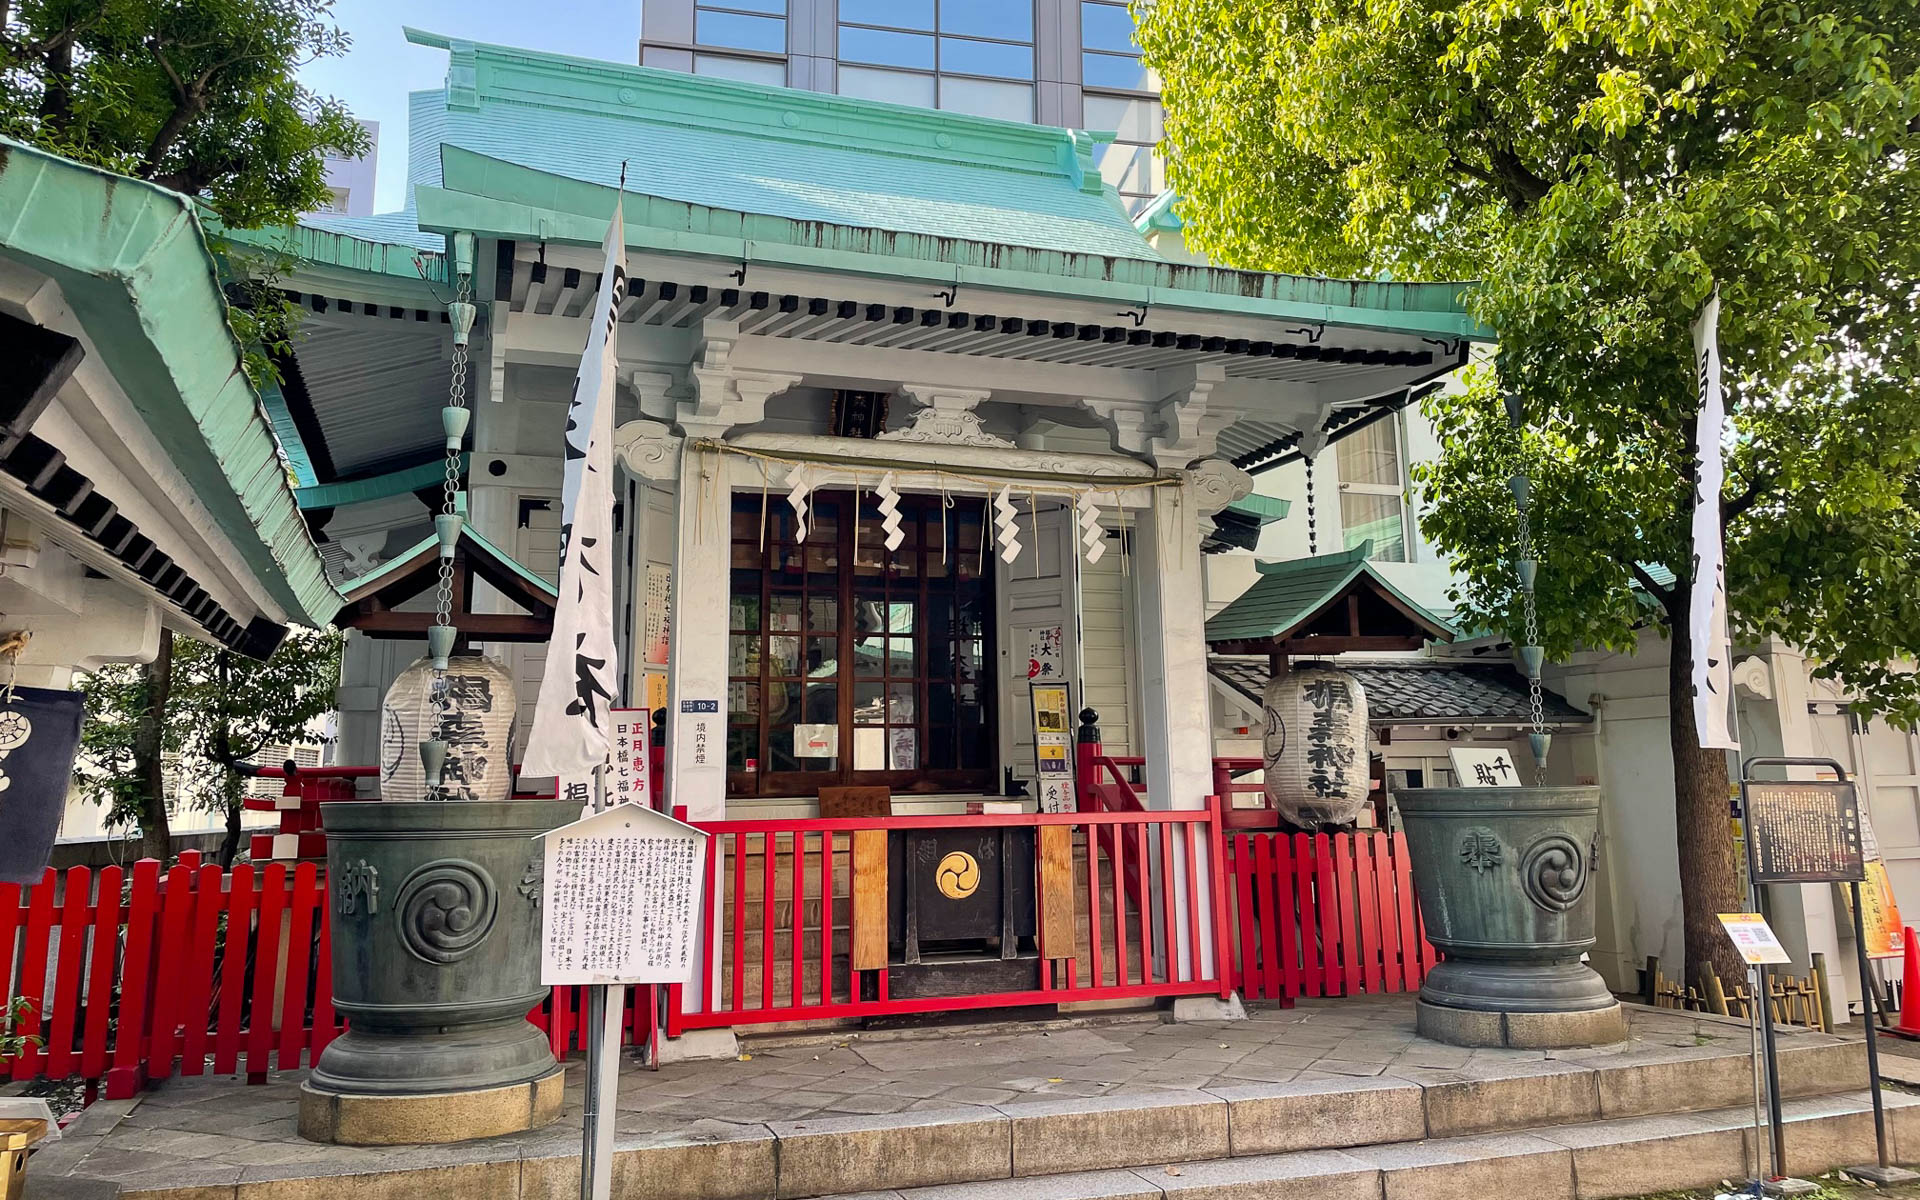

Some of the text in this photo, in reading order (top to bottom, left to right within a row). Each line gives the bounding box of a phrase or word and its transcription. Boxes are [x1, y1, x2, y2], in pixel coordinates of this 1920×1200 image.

[1040, 642, 1053, 676] 大祭
[697, 702, 716, 711] 10-2
[695, 722, 707, 764] 境内禁煙
[1303, 680, 1356, 799] 椙森神社
[631, 722, 645, 805] 正月恵方
[1472, 762, 1498, 786] 貼
[1492, 755, 1512, 780] 千
[1046, 784, 1060, 813] 受付
